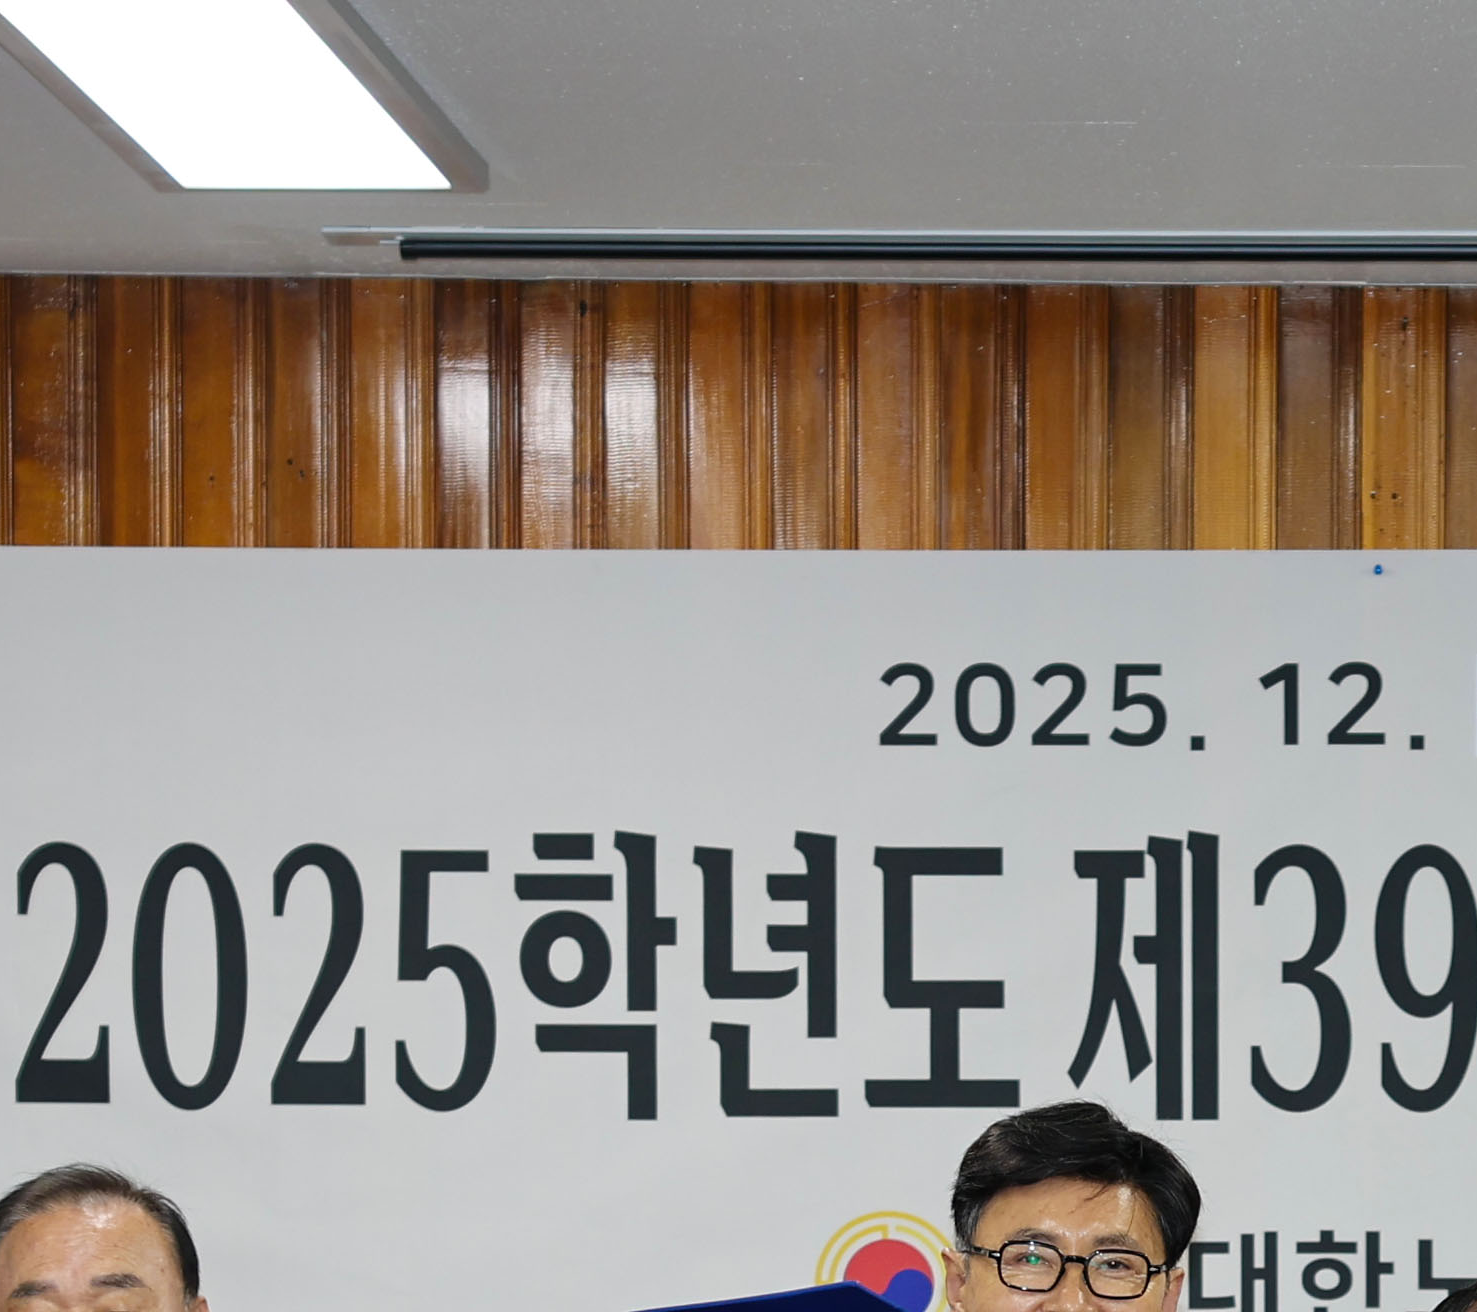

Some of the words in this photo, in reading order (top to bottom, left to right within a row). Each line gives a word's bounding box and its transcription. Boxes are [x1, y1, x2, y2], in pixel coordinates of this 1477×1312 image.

[879, 661, 1206, 751] 2025.
[1258, 661, 1426, 751] 12.
[15, 829, 1022, 1121] 2025학년도
